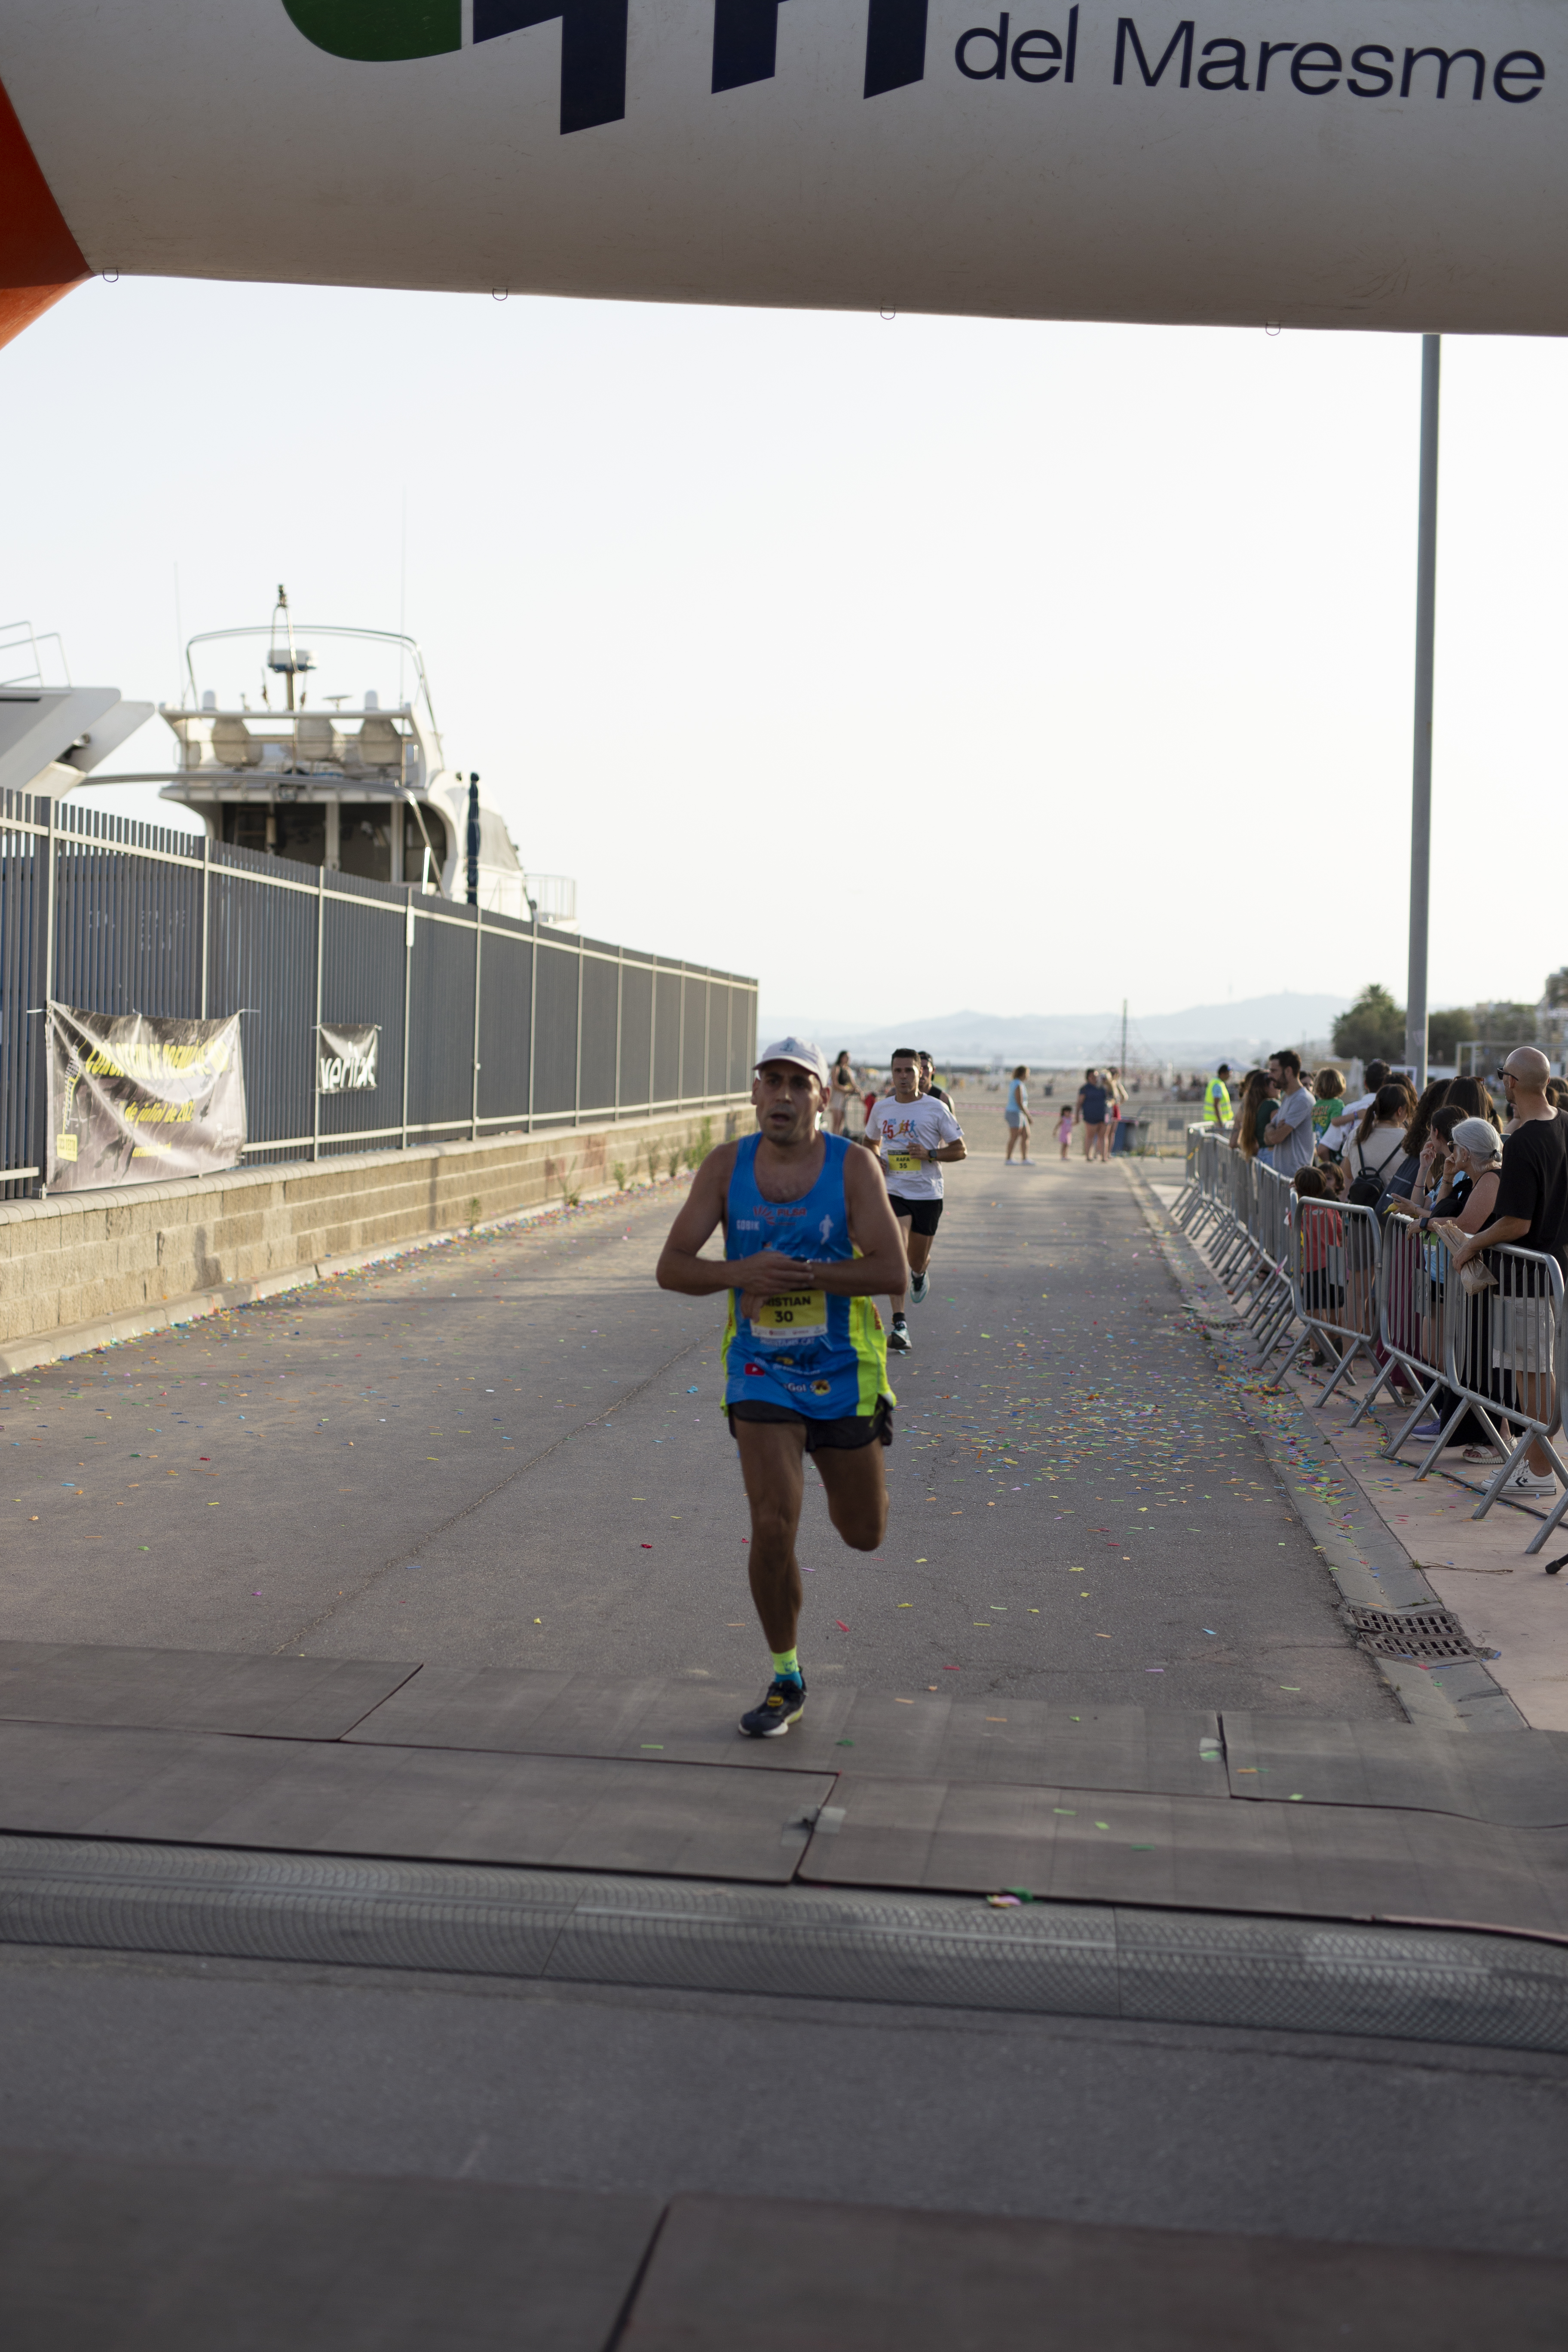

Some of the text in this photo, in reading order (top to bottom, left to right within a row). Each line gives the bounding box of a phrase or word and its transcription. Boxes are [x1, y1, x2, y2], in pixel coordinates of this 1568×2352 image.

[955, 3, 1079, 83] del
[1113, 17, 1546, 104] Maresme
[134, 1102, 168, 1128] juliol
[882, 1120, 894, 1139] 25
[775, 1311, 793, 1323] 30
